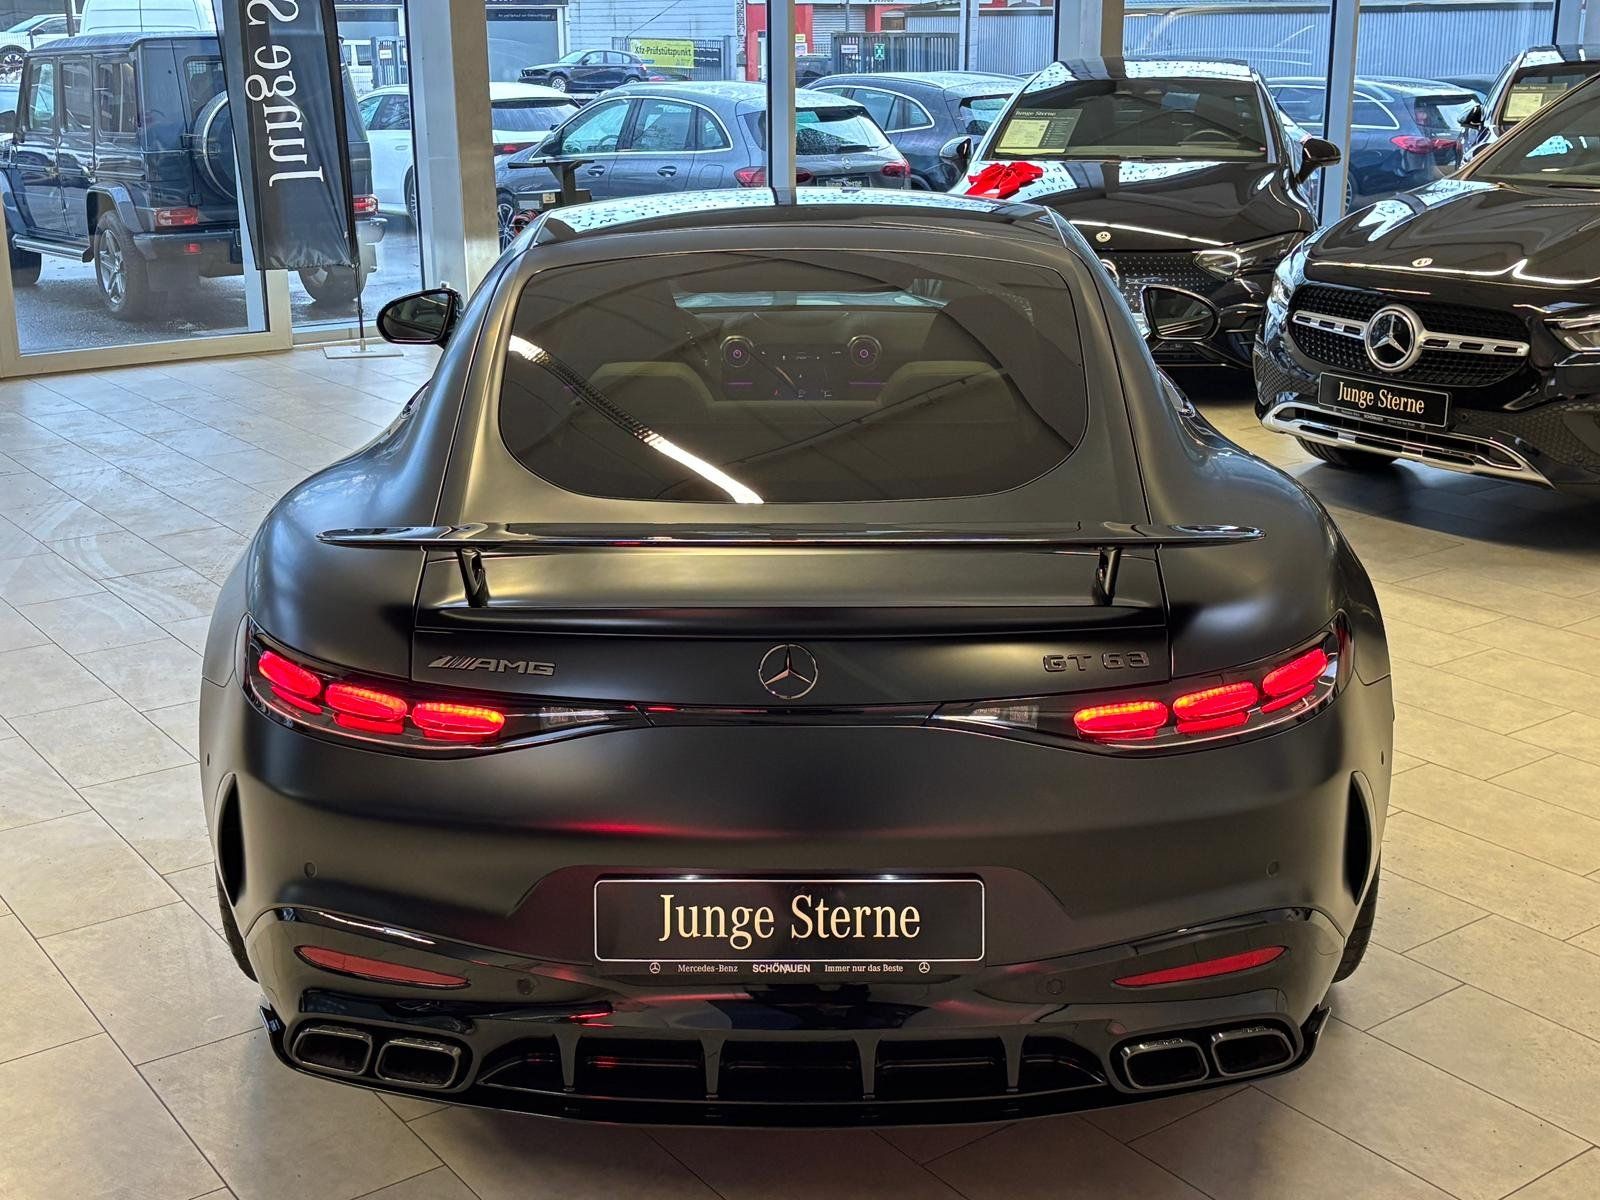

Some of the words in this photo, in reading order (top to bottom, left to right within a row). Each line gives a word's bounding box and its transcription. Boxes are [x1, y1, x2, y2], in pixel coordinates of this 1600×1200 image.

[634, 45, 692, 57] Kfz-Prüfstützpunkt
[1337, 381, 1374, 409] Junge
[1377, 388, 1425, 414] Sterne
[1043, 653, 1092, 672] GT
[1101, 650, 1150, 669] 63
[659, 894, 775, 950] Junge
[791, 894, 921, 939] Sterne
[677, 964, 739, 973] Mercedes-Benz
[824, 964, 851, 973] Immer
[852, 965, 866, 973] nur
[868, 964, 881, 973] das
[883, 964, 904, 973] Beste
